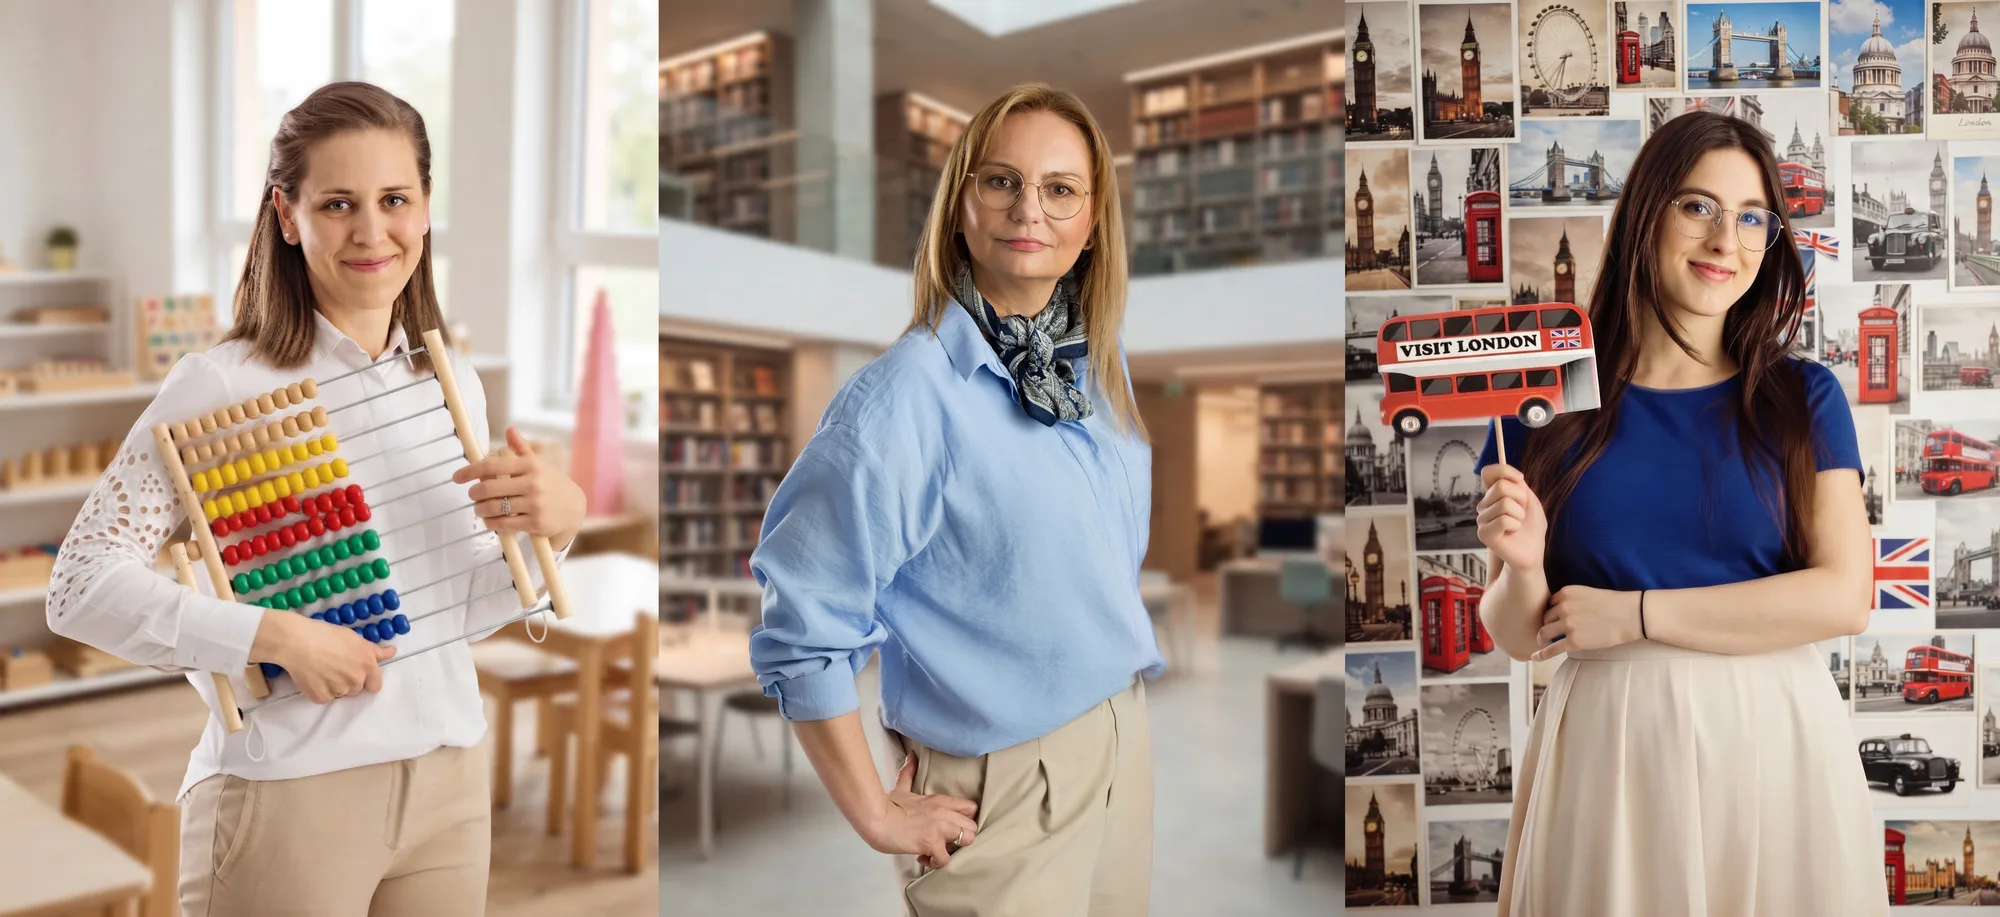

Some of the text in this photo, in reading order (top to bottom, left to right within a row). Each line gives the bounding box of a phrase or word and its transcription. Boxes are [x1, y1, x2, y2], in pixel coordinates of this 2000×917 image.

[1958, 117, 1992, 127] London
[1400, 334, 1537, 357] VISIT LONDON
